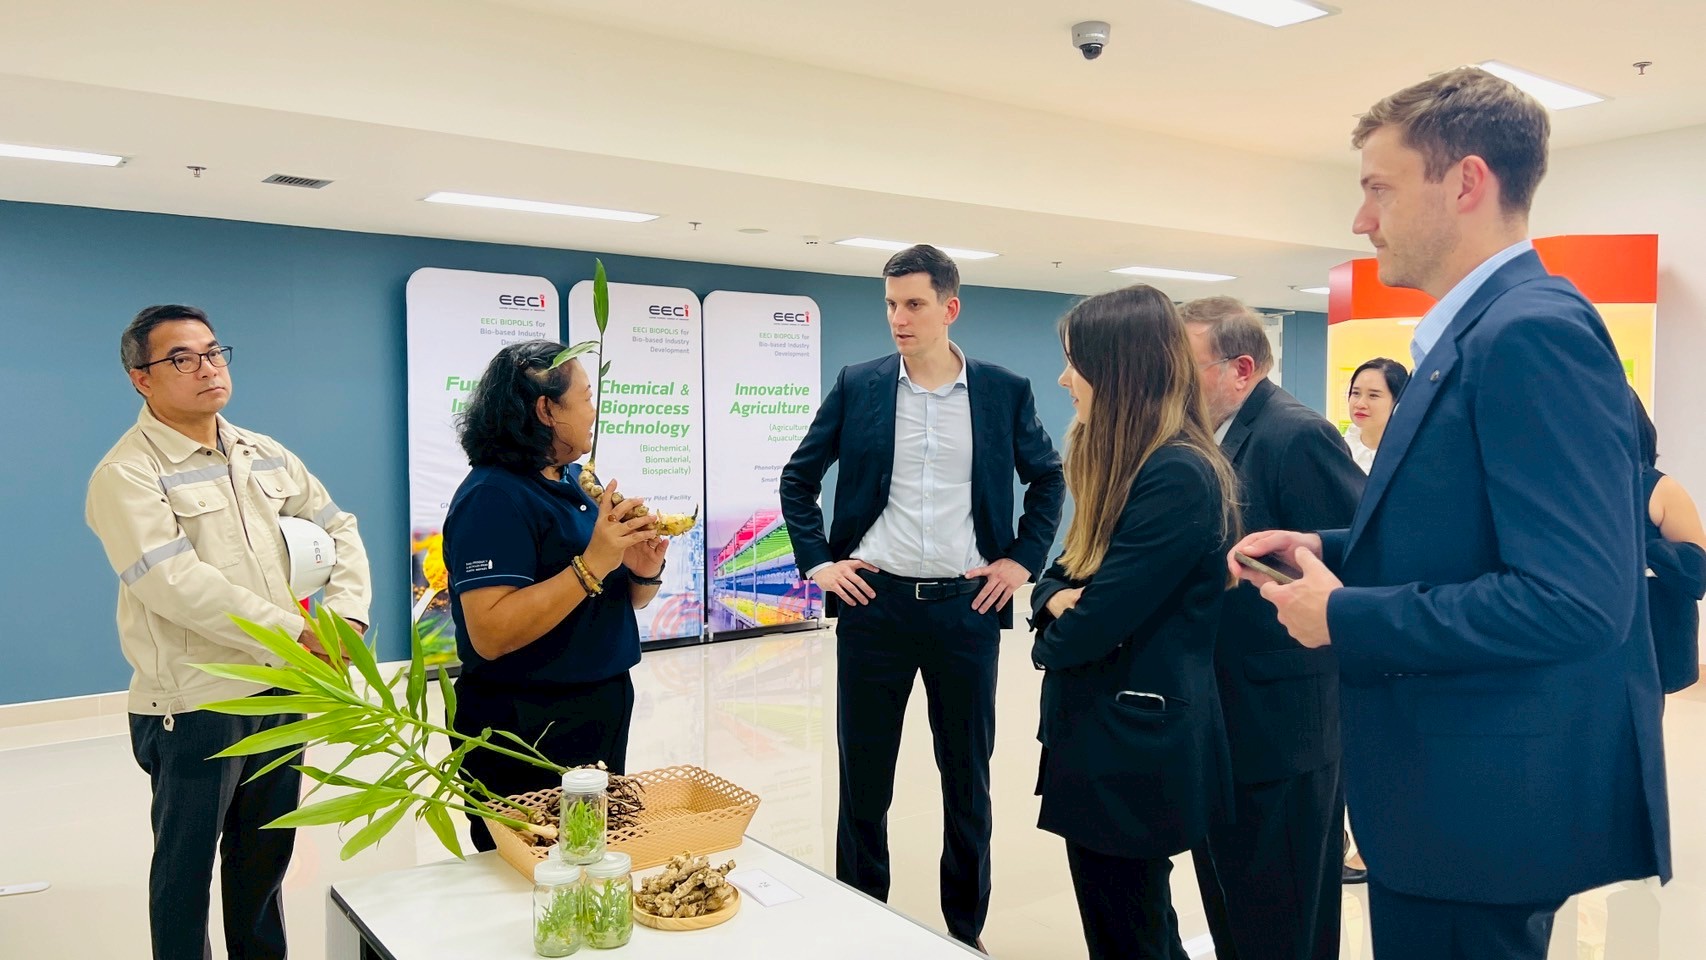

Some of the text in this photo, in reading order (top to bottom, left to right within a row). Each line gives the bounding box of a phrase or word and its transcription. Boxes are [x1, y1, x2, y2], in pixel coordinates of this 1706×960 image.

[500, 318, 533, 326] BIOPOLIS
[480, 328, 546, 338] Bio-based Industry
[650, 327, 678, 335] BIOPOLIS
[665, 338, 689, 346] Industry
[650, 346, 689, 354] Development
[600, 380, 689, 395] Chemical &
[735, 383, 810, 396] Innovative
[601, 400, 689, 417] Bioprocess
[730, 401, 810, 418] Agriculture
[599, 420, 690, 438] Technology
[640, 444, 691, 453] (Biochemical,
[645, 456, 691, 464] Biomaterial,
[642, 467, 691, 475] Biospecialty)
